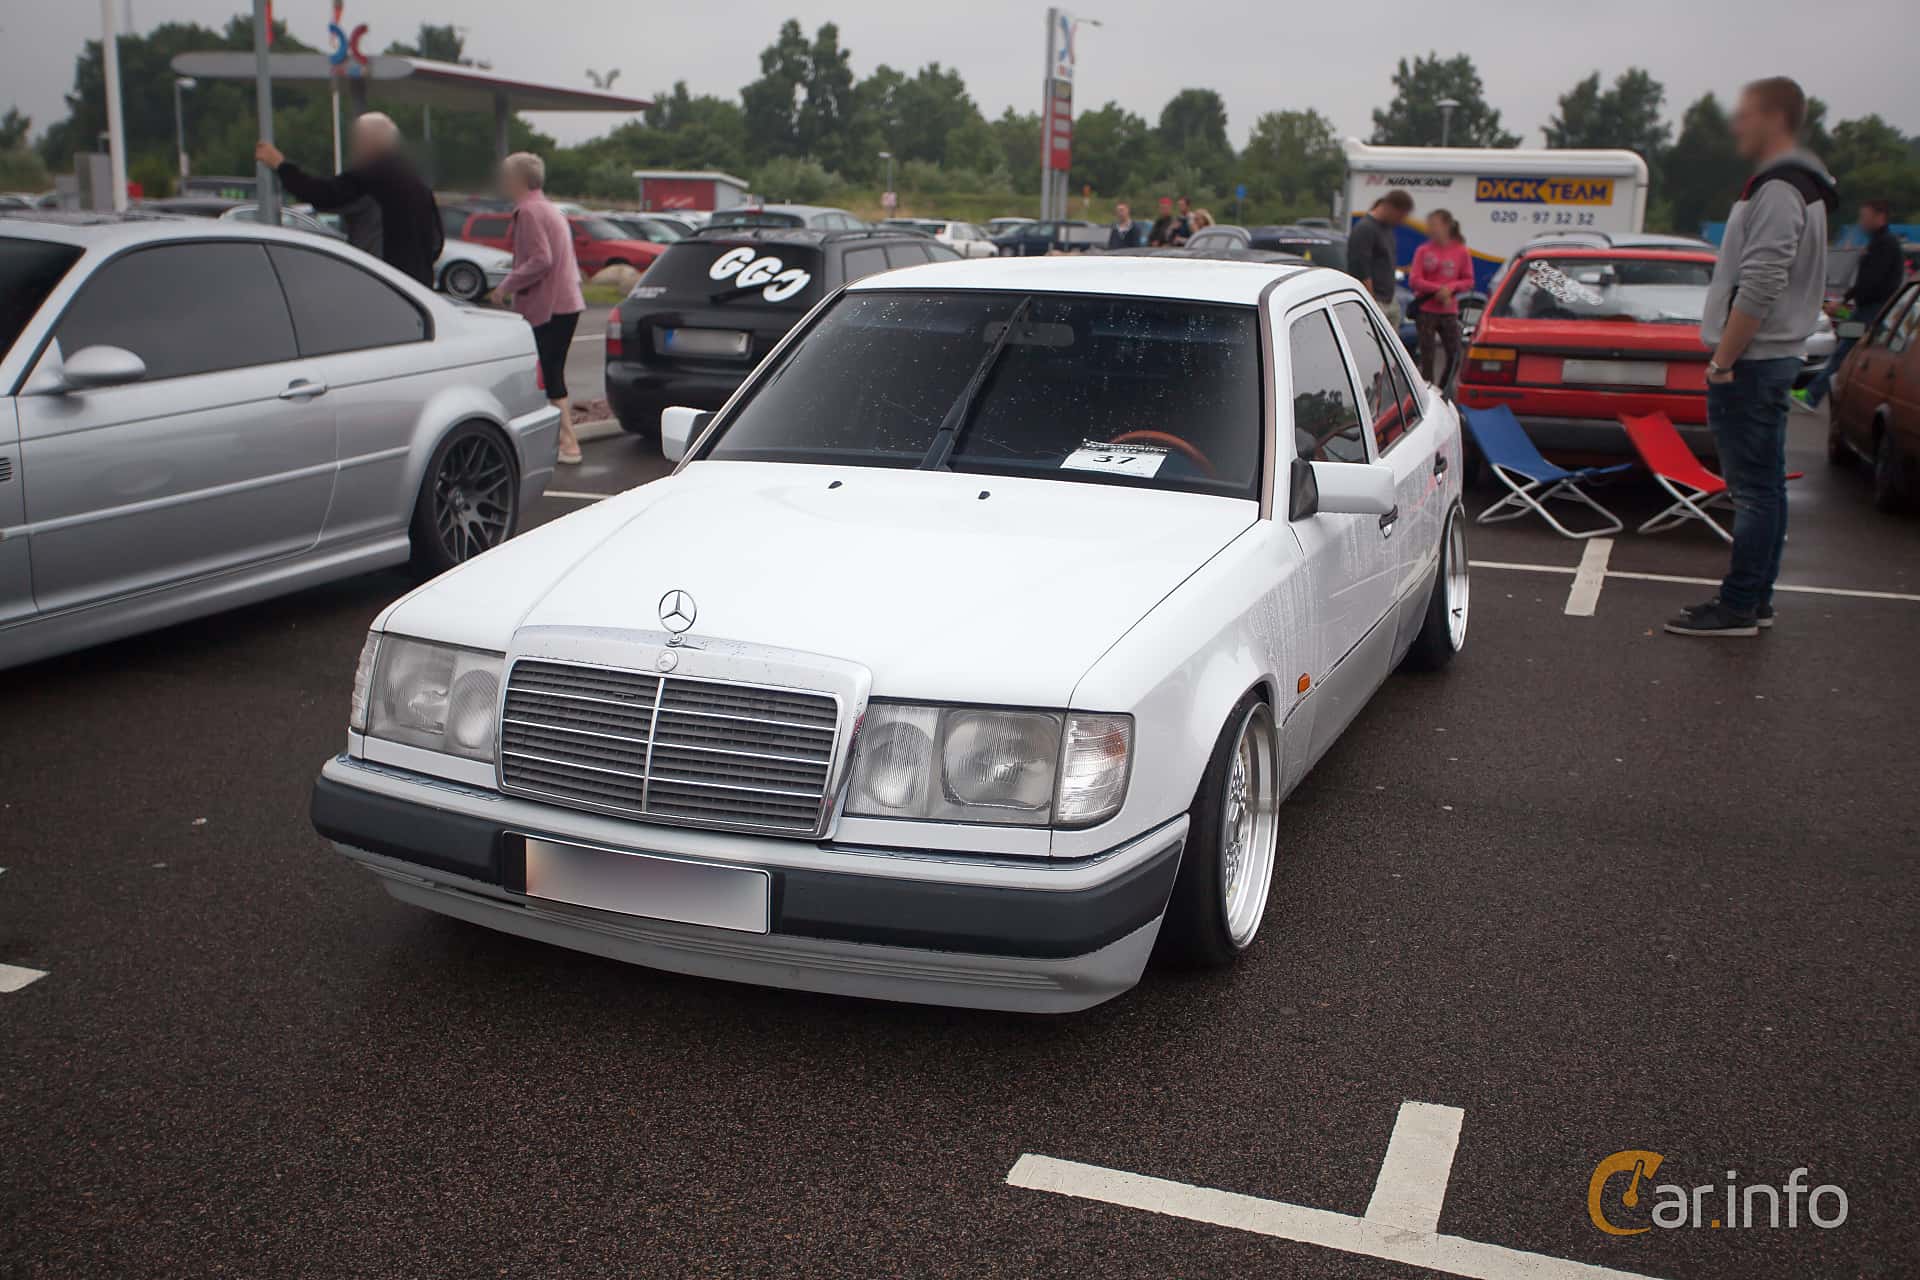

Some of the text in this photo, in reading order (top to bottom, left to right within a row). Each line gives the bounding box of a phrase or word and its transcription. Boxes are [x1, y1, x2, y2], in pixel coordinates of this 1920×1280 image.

[1477, 179, 1608, 201] DÄCK TEAM
[1490, 210, 1518, 223] 020
[1532, 211, 1550, 225] 97
[1092, 454, 1137, 465] 37
